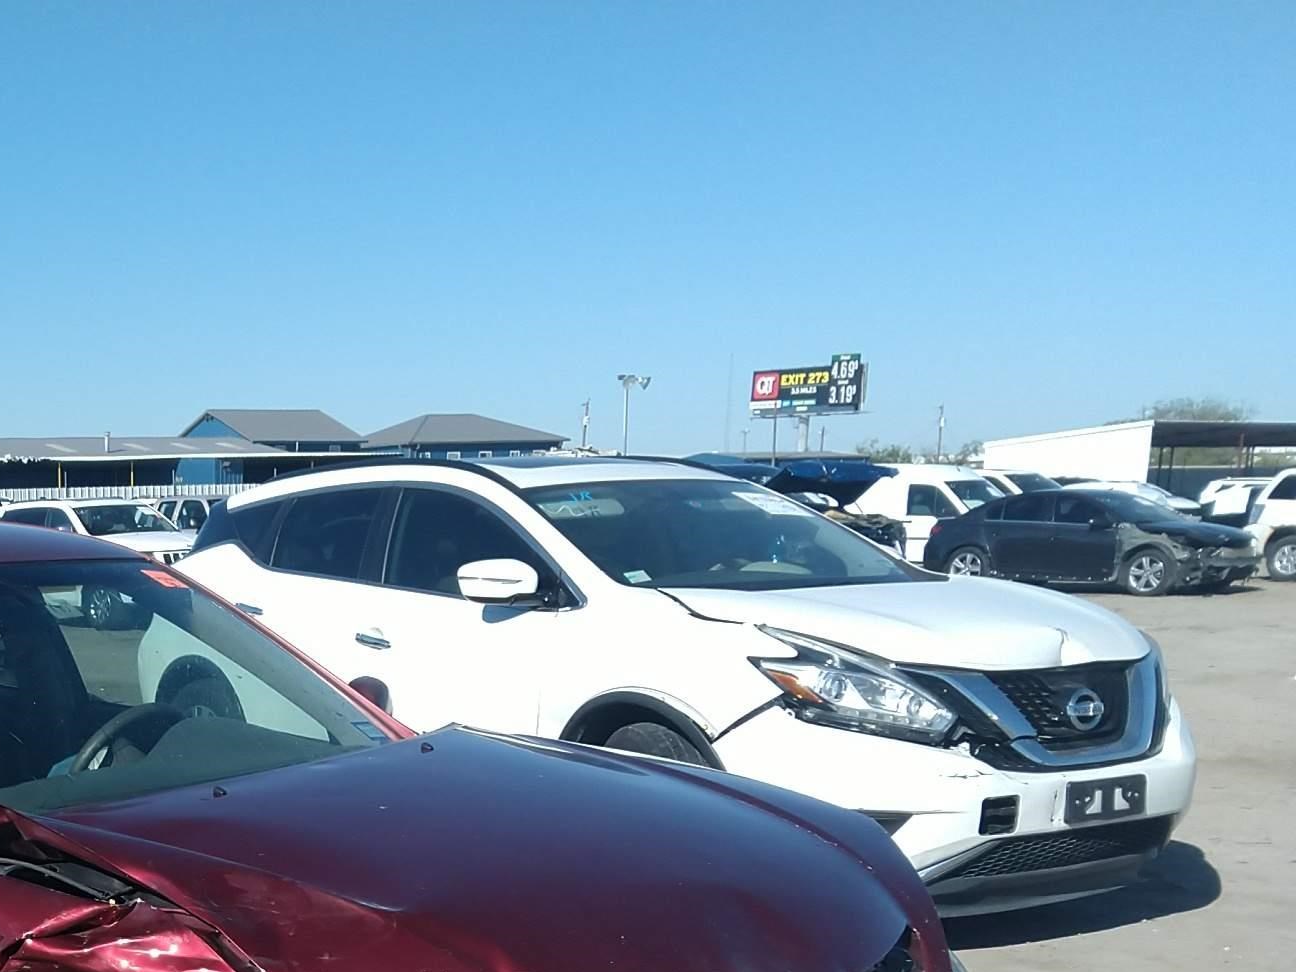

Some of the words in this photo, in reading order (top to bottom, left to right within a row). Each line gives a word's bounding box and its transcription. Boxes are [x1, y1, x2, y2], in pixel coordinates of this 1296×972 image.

[756, 376, 776, 396] QT
[780, 373, 806, 386] EXIT
[807, 371, 830, 384] 273
